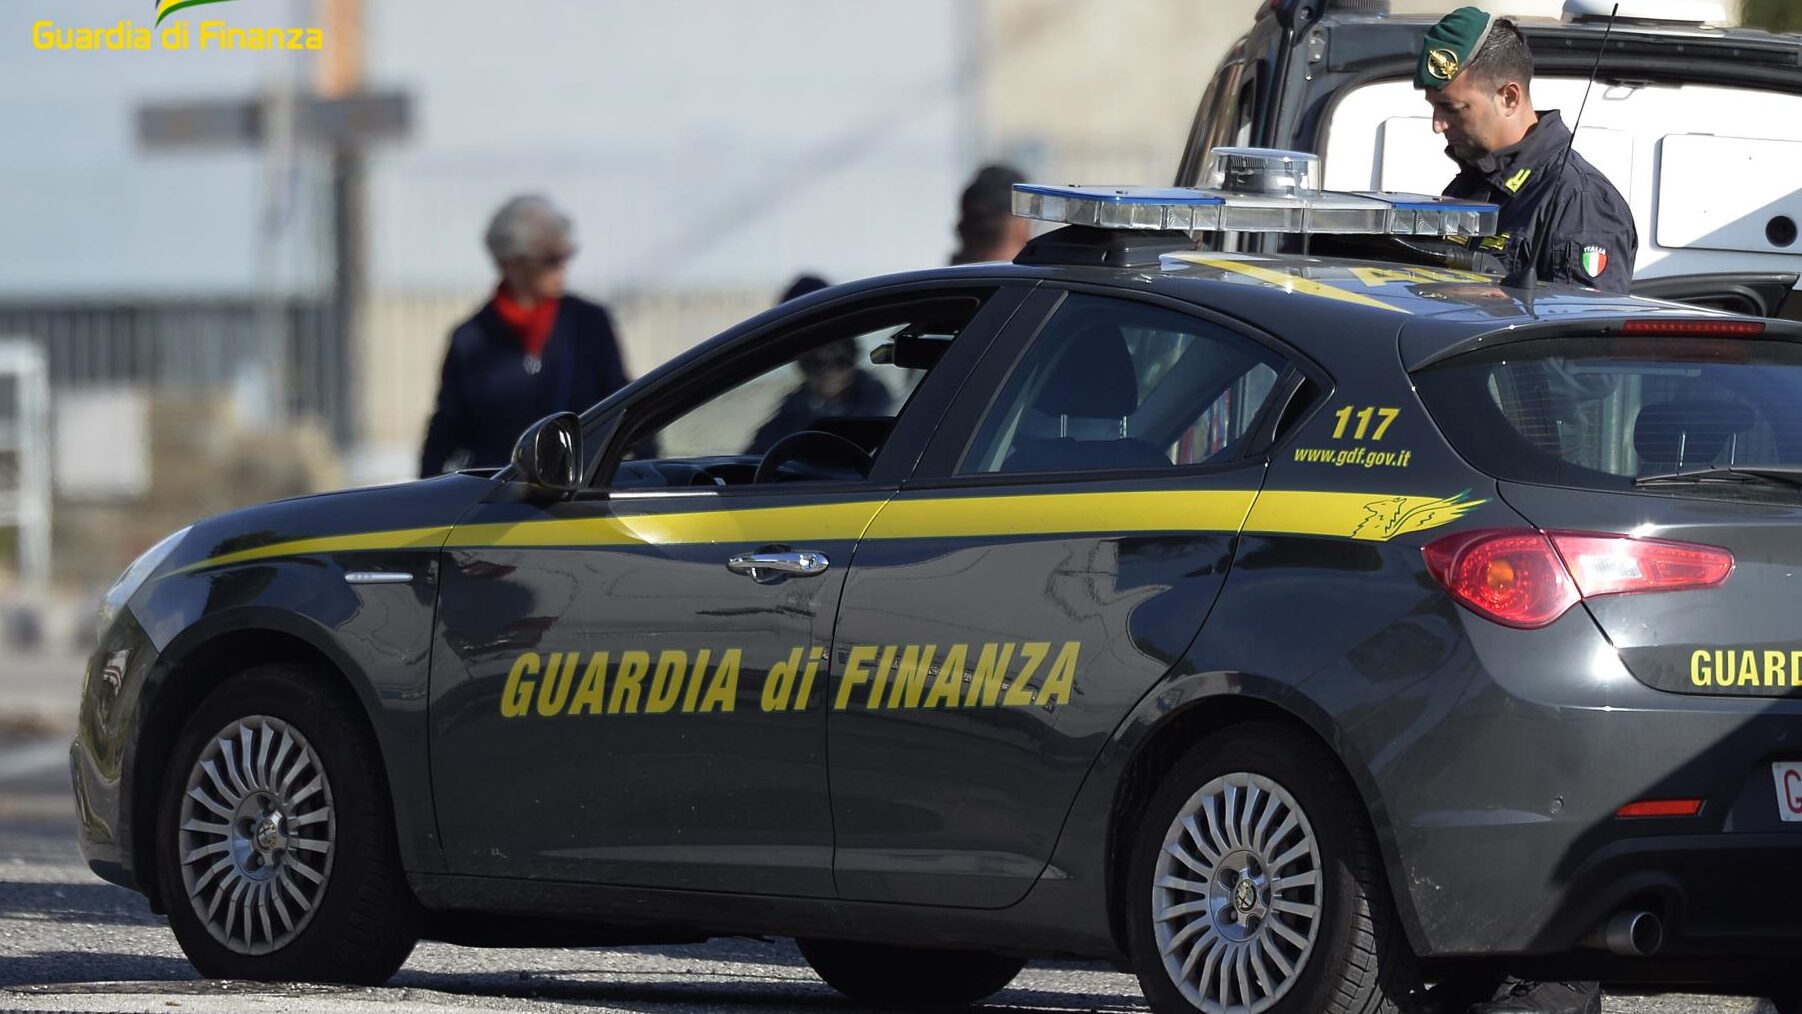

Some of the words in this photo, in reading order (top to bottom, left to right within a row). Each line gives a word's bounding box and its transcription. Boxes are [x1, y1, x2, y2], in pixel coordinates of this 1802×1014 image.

[1583, 245, 1607, 256] ITALIA
[1333, 405, 1401, 441] 117
[1294, 447, 1412, 467] www.gdf.gov.it
[500, 648, 743, 717] GUARDIA
[760, 646, 821, 712] di
[833, 641, 1081, 710] FINANZA
